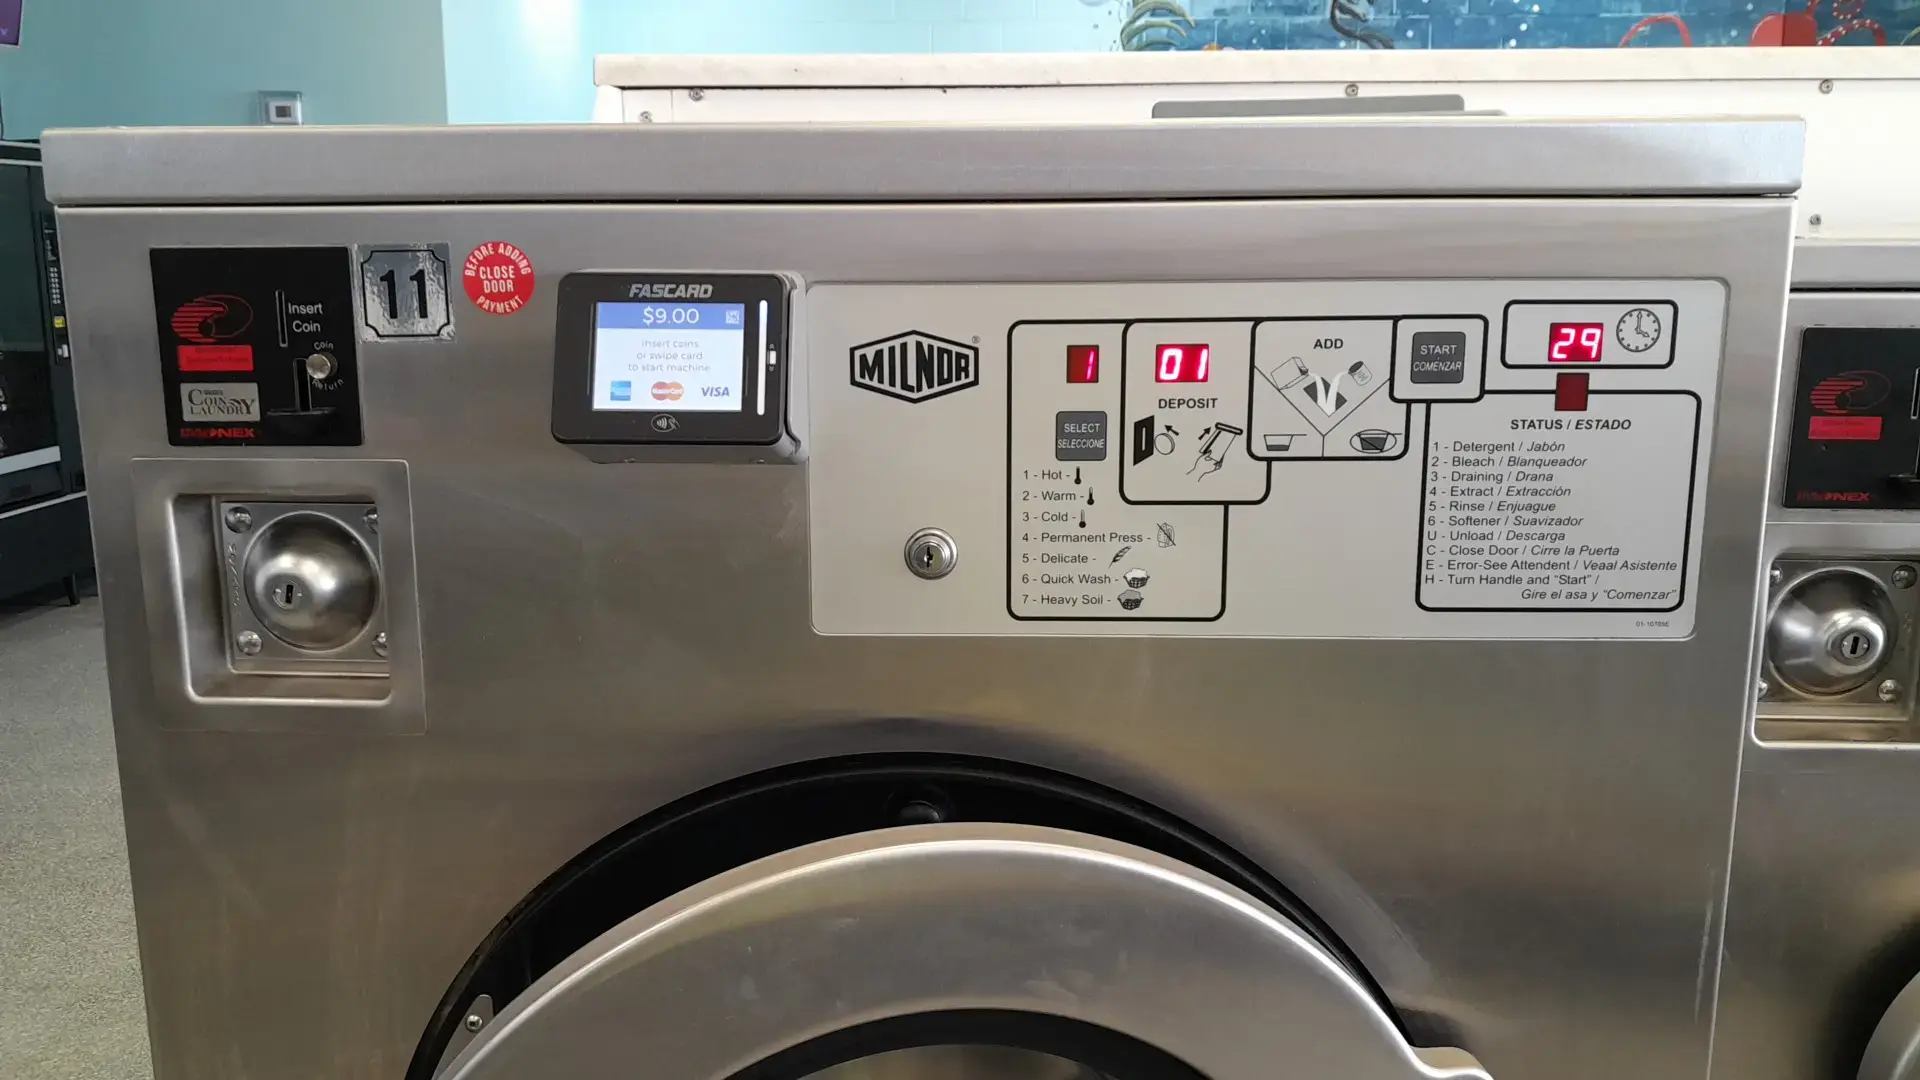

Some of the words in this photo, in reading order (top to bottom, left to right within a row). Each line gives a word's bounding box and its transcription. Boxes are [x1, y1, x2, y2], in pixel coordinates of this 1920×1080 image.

[464, 243, 495, 277] BEFORE
[497, 242, 532, 275] ADDING
[479, 265, 515, 280] CLOSE
[483, 279, 514, 294] DOOR
[629, 284, 713, 298] FASCARD
[379, 268, 429, 320] 11
[288, 302, 323, 315] Insert
[476, 294, 523, 314] PAYMENT
[642, 306, 700, 327] $9.00
[292, 320, 321, 332] Coin
[313, 340, 334, 350] Coin
[672, 340, 700, 348] coins
[1313, 338, 1344, 350] ADD
[1552, 327, 1602, 359] 29
[649, 352, 678, 362] swipe
[680, 350, 703, 360] card
[1420, 344, 1458, 356] START
[628, 364, 638, 372] to
[666, 362, 711, 372] machine
[858, 340, 970, 394] MILNOR
[1086, 350, 1095, 380] 1
[1159, 347, 1208, 382] 01
[701, 386, 730, 397] VISA
[190, 399, 255, 416] LAUNDRY
[1158, 398, 1218, 410] DEPOSIT
[1064, 423, 1101, 433] SELECT
[1510, 419, 1563, 430] STATUS
[1574, 419, 1632, 430] ESTADO
[1057, 438, 1105, 449] SELECCIONE
[1434, 442, 1439, 452] 1
[1453, 441, 1515, 454] Detergent
[1526, 441, 1566, 452] Jabón
[1431, 456, 1440, 467] 2
[1452, 456, 1495, 467] Bleach
[1507, 456, 1588, 469] Blanqueador
[1023, 470, 1028, 480] 1
[1042, 470, 1062, 480] Hot
[1430, 472, 1439, 482] 3
[1451, 471, 1504, 484] Draining
[1515, 472, 1554, 482] Drana
[1022, 491, 1030, 501] 2
[1042, 491, 1076, 501] Warm
[1429, 486, 1437, 497] 4
[1450, 486, 1494, 497] Extract
[1506, 486, 1572, 497] Extracción
[1428, 501, 1436, 512] 5
[1449, 500, 1485, 512] Rinse
[1497, 501, 1556, 514] Enjuague
[1022, 512, 1030, 522] 3
[1041, 512, 1068, 522] Cold
[1428, 516, 1436, 526] 6
[1448, 515, 1501, 526] Softener
[1513, 516, 1584, 526] Suavizador
[1022, 532, 1029, 542] 4
[1042, 532, 1106, 542] Permanent
[1110, 532, 1144, 542] Press
[1428, 530, 1437, 541] U
[1450, 530, 1494, 541] Unload
[1506, 530, 1566, 544] Descarga
[1426, 546, 1436, 556] C
[1448, 545, 1484, 556] Close
[1488, 546, 1518, 556] Door
[1530, 545, 1560, 556] Cirre
[1564, 546, 1576, 556] la
[1578, 546, 1620, 556] Puerta
[1022, 554, 1030, 564] 5
[1042, 553, 1088, 564] Delicate
[1426, 560, 1434, 570] E
[1448, 560, 1508, 570] Error-See
[1510, 560, 1570, 570] Attendent
[1583, 560, 1617, 571] Veaal
[1620, 560, 1678, 572] Asistente
[1022, 574, 1029, 584] 6
[1041, 574, 1074, 584] Quick
[1078, 574, 1112, 584] Wash
[1425, 574, 1435, 585] H
[1448, 574, 1476, 585] Turn
[1480, 574, 1523, 585] Handle
[1526, 574, 1550, 585] and
[1022, 595, 1029, 605] 7
[1041, 594, 1078, 607] Heavy
[1082, 594, 1104, 605] Soil
[1520, 589, 1547, 600] Gire
[1550, 589, 1562, 600] el
[1564, 592, 1588, 600] asa
[1590, 592, 1598, 602] y
